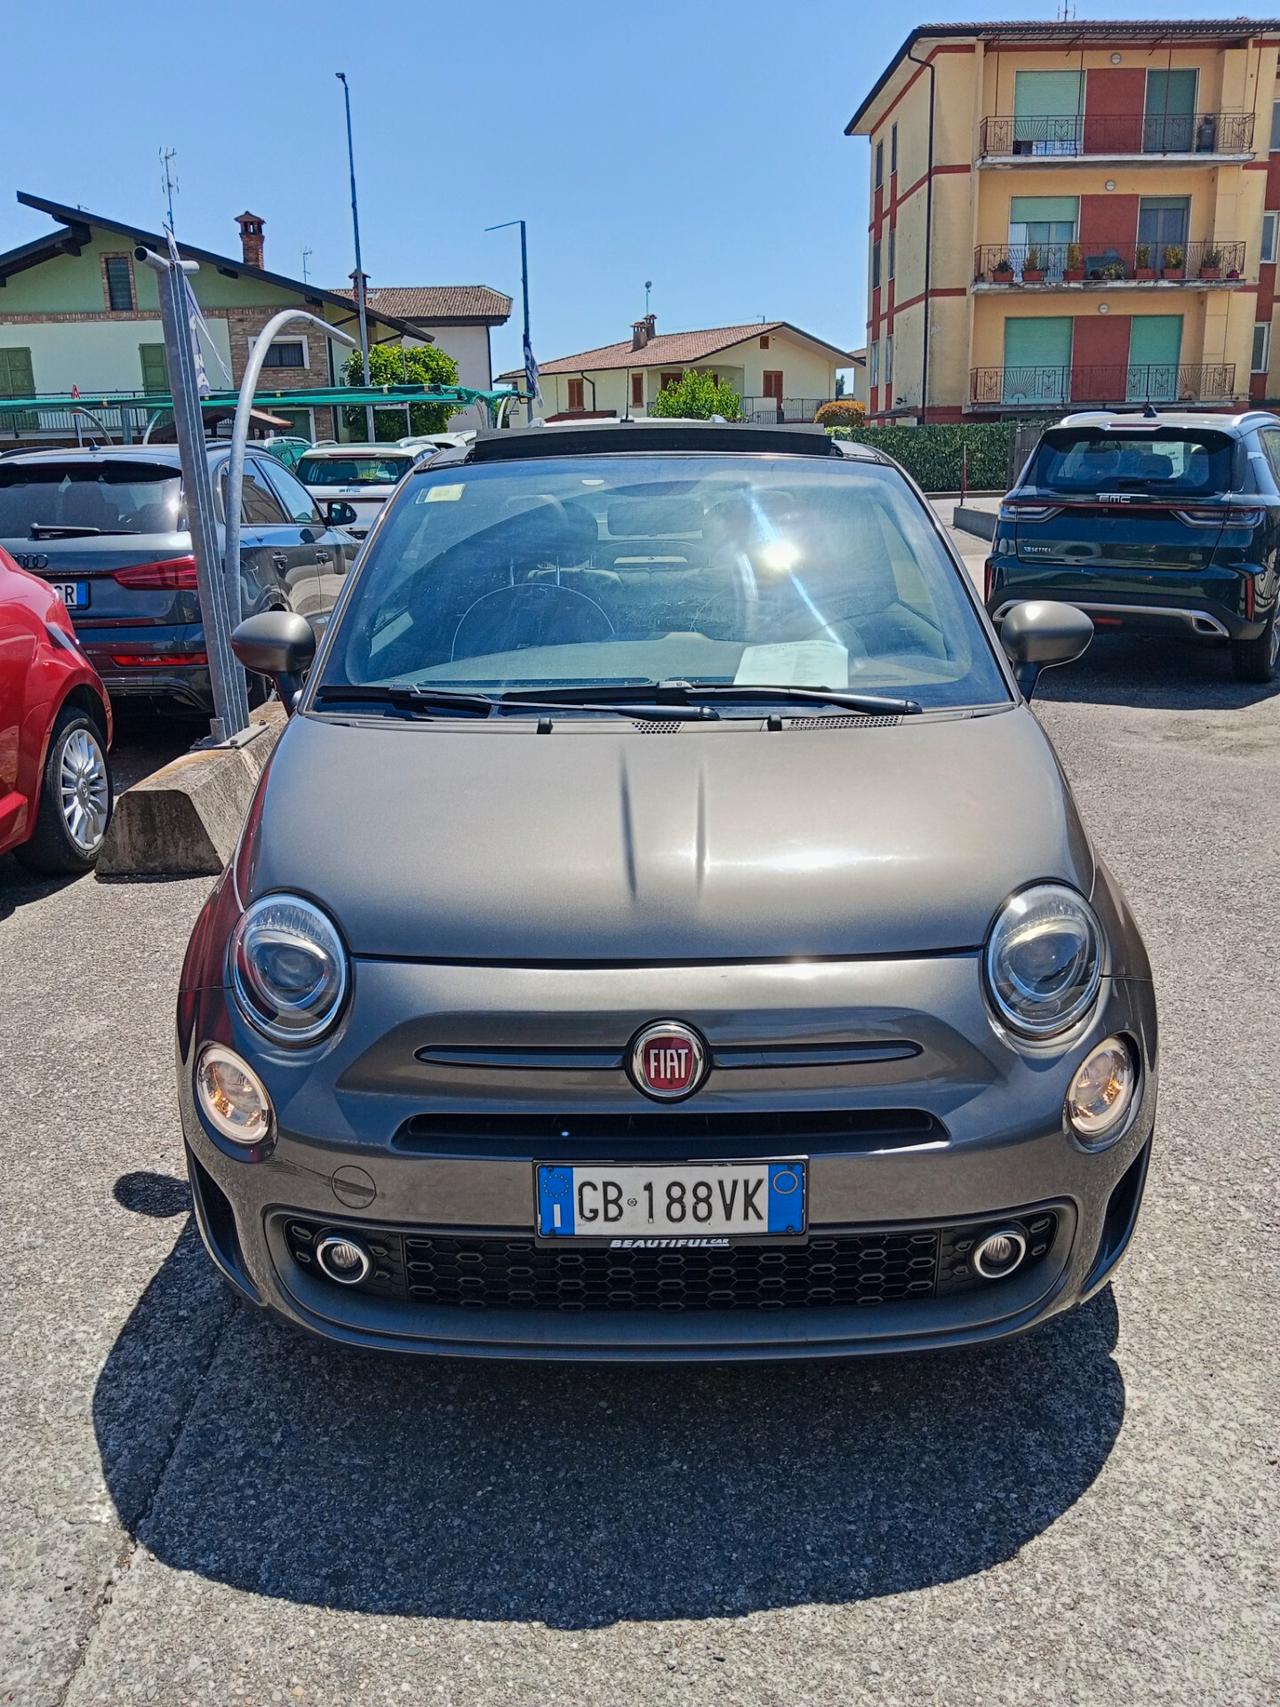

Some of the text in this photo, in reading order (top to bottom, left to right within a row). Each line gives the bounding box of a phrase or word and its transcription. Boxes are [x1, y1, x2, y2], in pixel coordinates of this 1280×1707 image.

[649, 1049, 689, 1079] FIAT
[577, 1179, 764, 1224] GB 188VK
[610, 1239, 709, 1248] BEAUTIFUL
